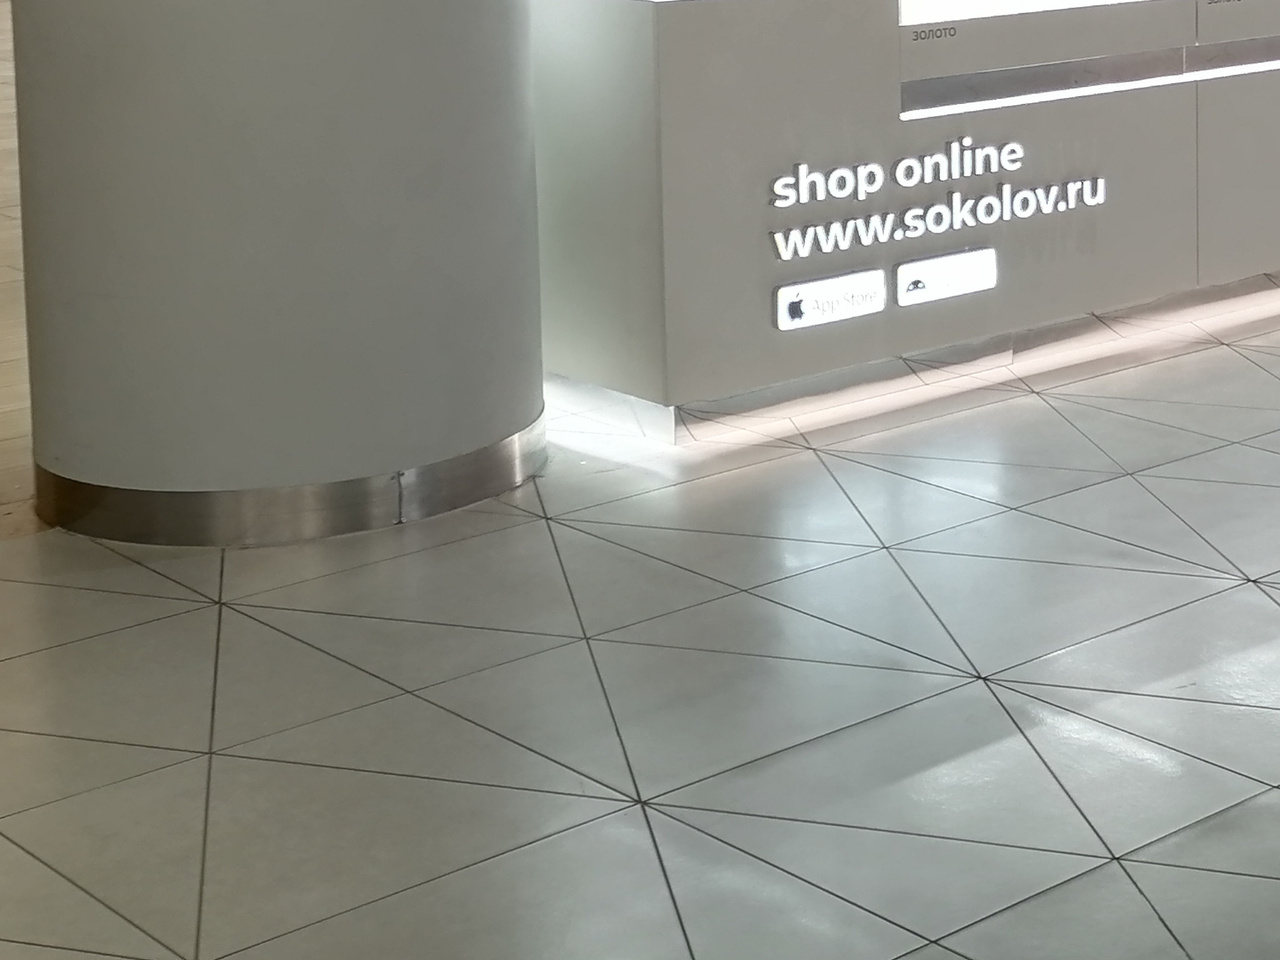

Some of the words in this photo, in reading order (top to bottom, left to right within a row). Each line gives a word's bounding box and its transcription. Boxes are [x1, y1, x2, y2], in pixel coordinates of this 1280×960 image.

[772, 163, 885, 208] shop
[894, 137, 1026, 188] online
[773, 177, 1107, 262] www.sokolov.ru
